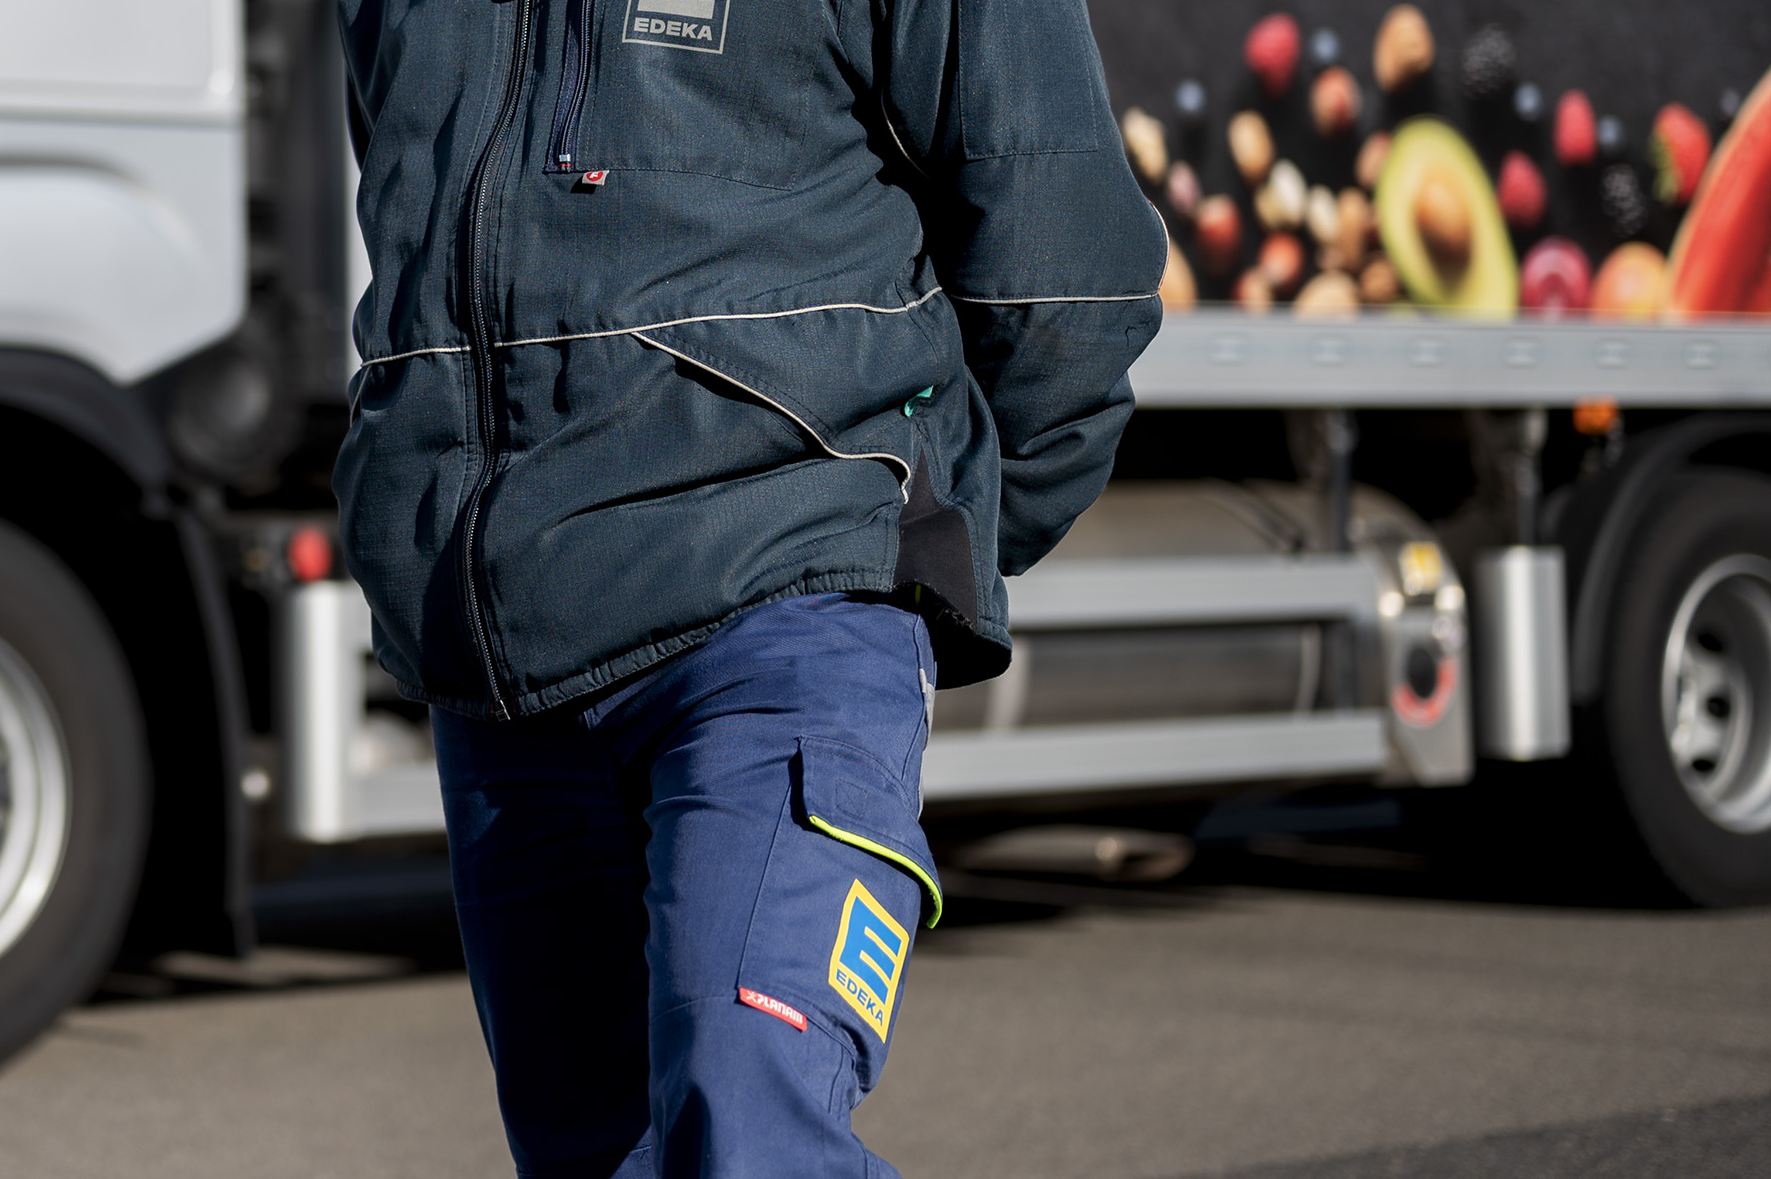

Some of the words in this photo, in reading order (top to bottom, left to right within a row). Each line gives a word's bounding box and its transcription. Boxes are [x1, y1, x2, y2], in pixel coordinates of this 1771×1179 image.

[633, 17, 713, 41] EDEKA
[839, 895, 902, 1006] E
[757, 993, 804, 1025] PLANAM
[835, 968, 884, 1027] EDEKA
